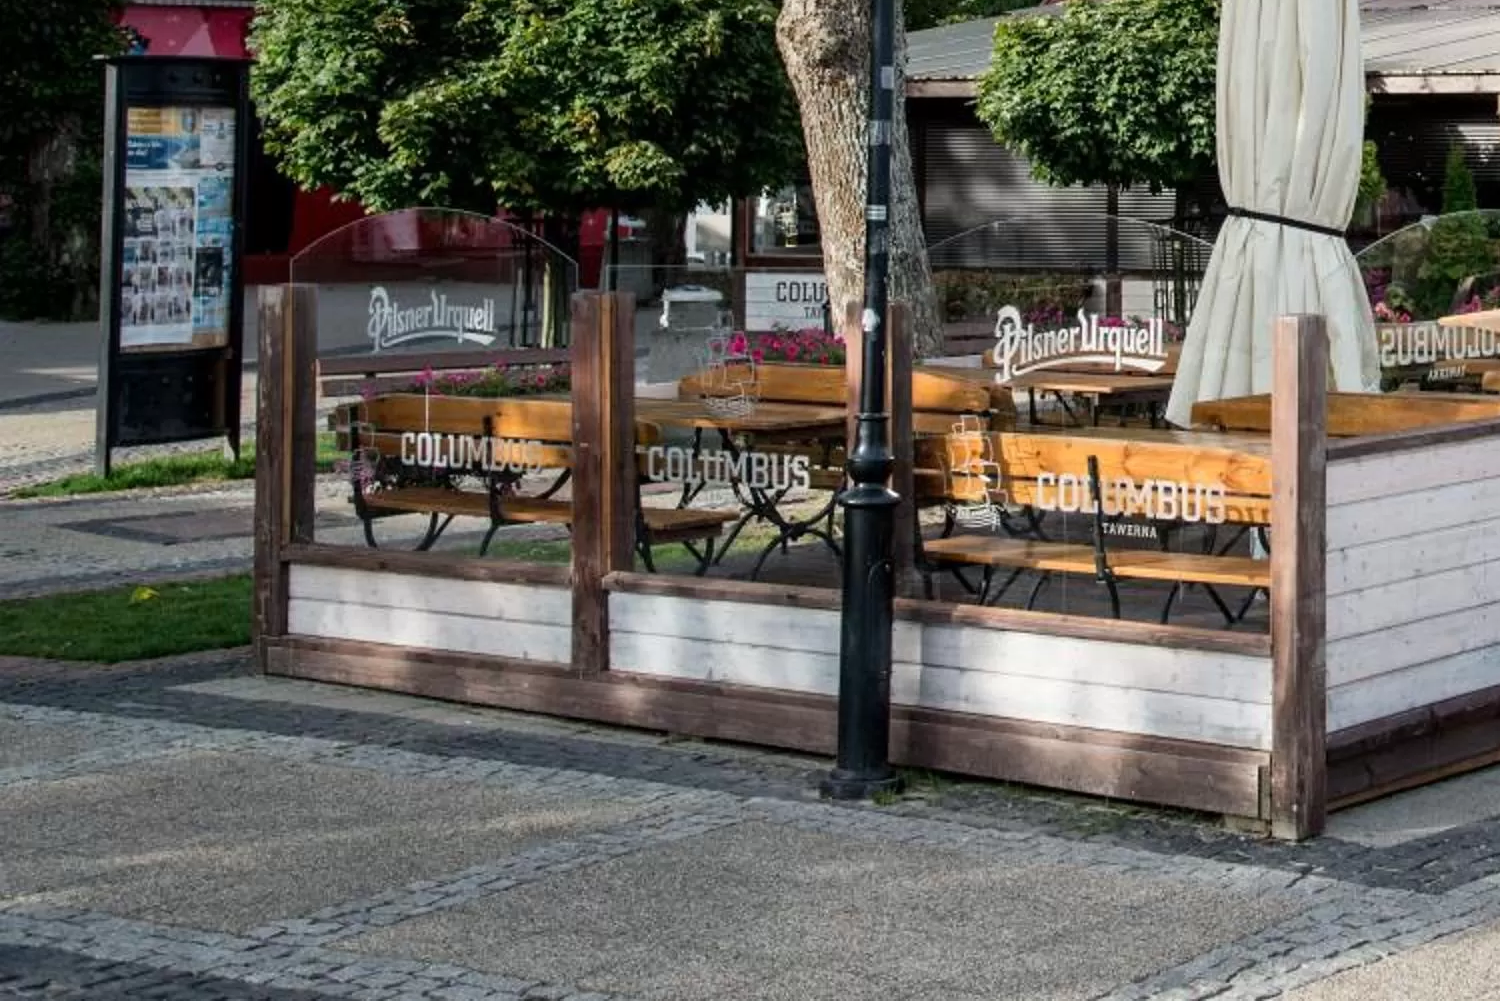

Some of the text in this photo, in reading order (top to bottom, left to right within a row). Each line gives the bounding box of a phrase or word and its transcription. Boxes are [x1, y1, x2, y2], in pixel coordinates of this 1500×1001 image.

[776, 282, 829, 303] COLU
[367, 286, 497, 354] Pilsner Urquell
[993, 304, 1168, 383] Pilsner Urquell
[648, 445, 811, 491] COLUMBUS
[1037, 471, 1225, 525] COLUMBUS
[1102, 522, 1157, 539] TAWERNA
